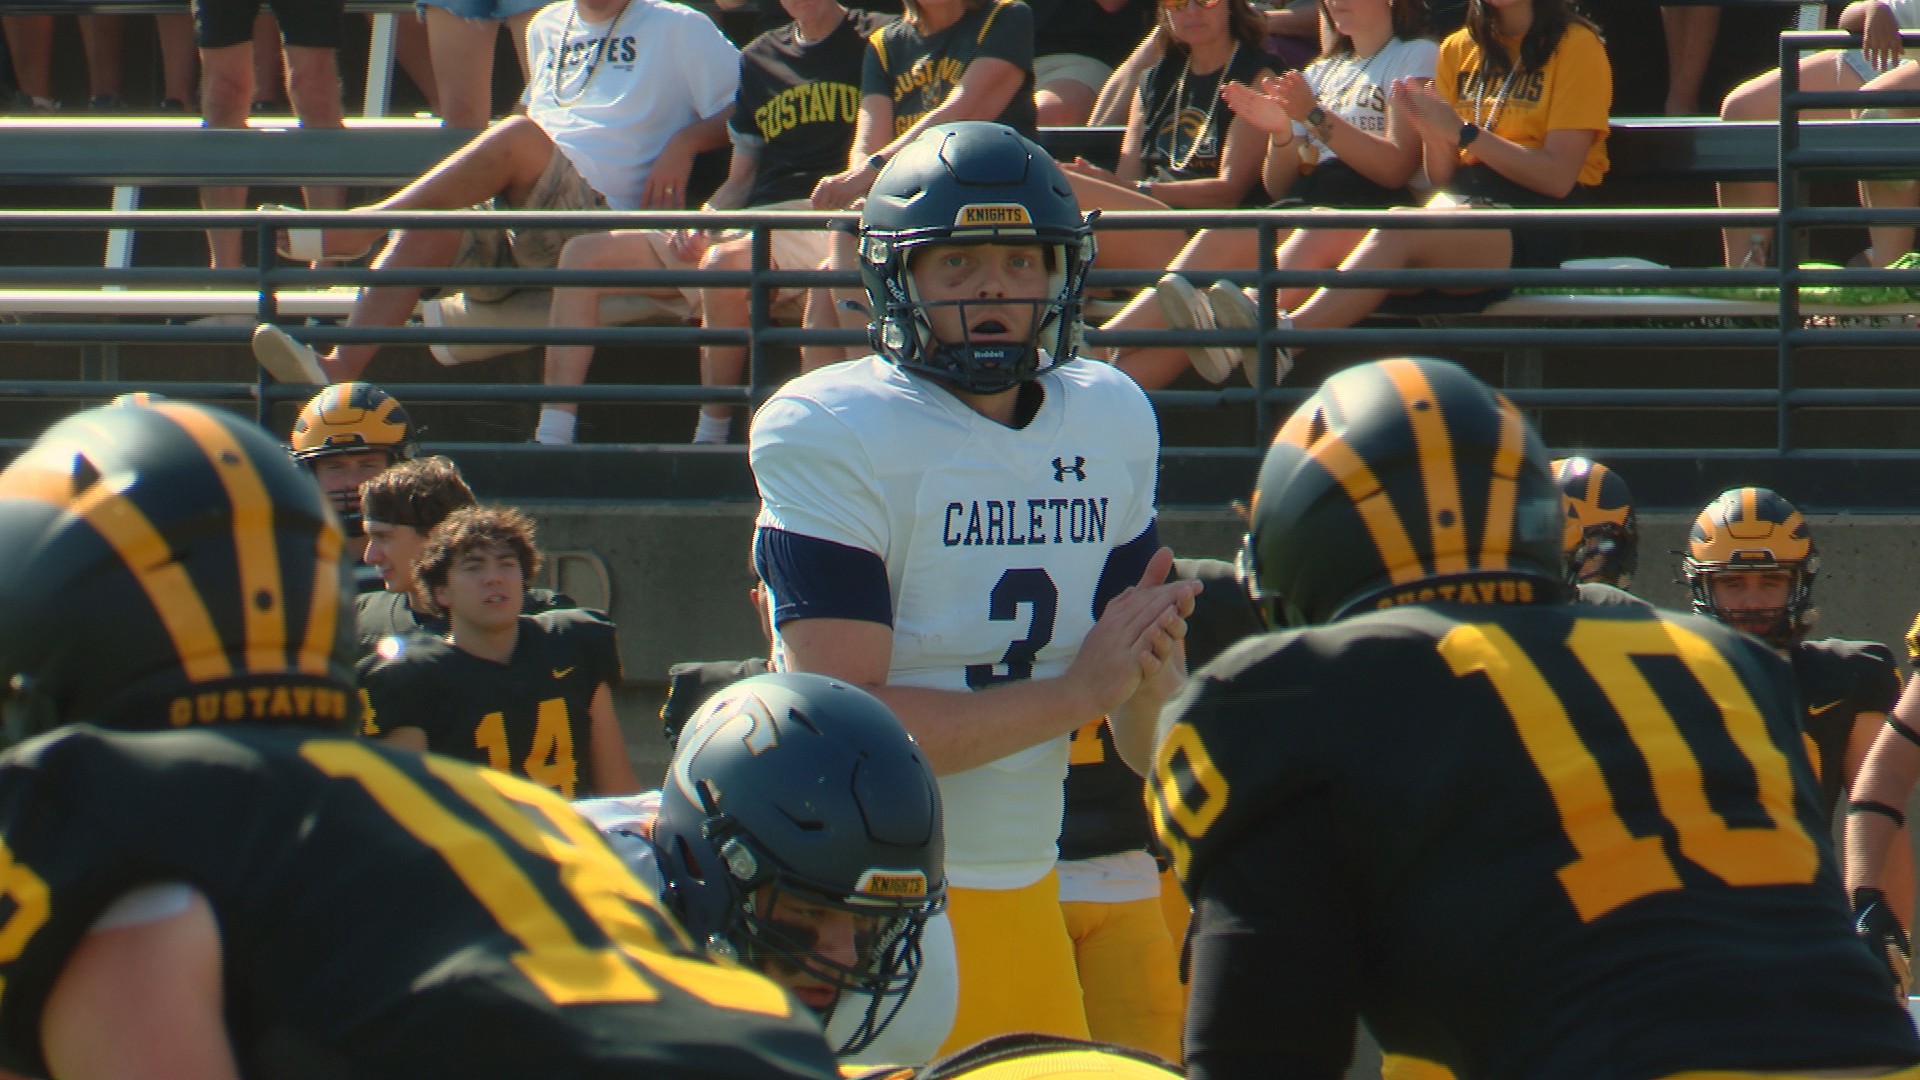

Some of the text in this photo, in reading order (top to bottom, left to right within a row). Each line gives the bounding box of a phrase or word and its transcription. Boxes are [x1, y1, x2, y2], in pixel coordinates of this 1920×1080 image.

[754, 82, 862, 143] GUSTAVU
[967, 208, 1022, 222] KNIGHTS
[943, 497, 1108, 546] CARLETON
[965, 567, 1059, 693] 3
[168, 684, 347, 728] GUSTAVUS
[474, 697, 578, 800] 14
[1436, 617, 1821, 925] 10
[870, 876, 921, 893] KNIGHTS
